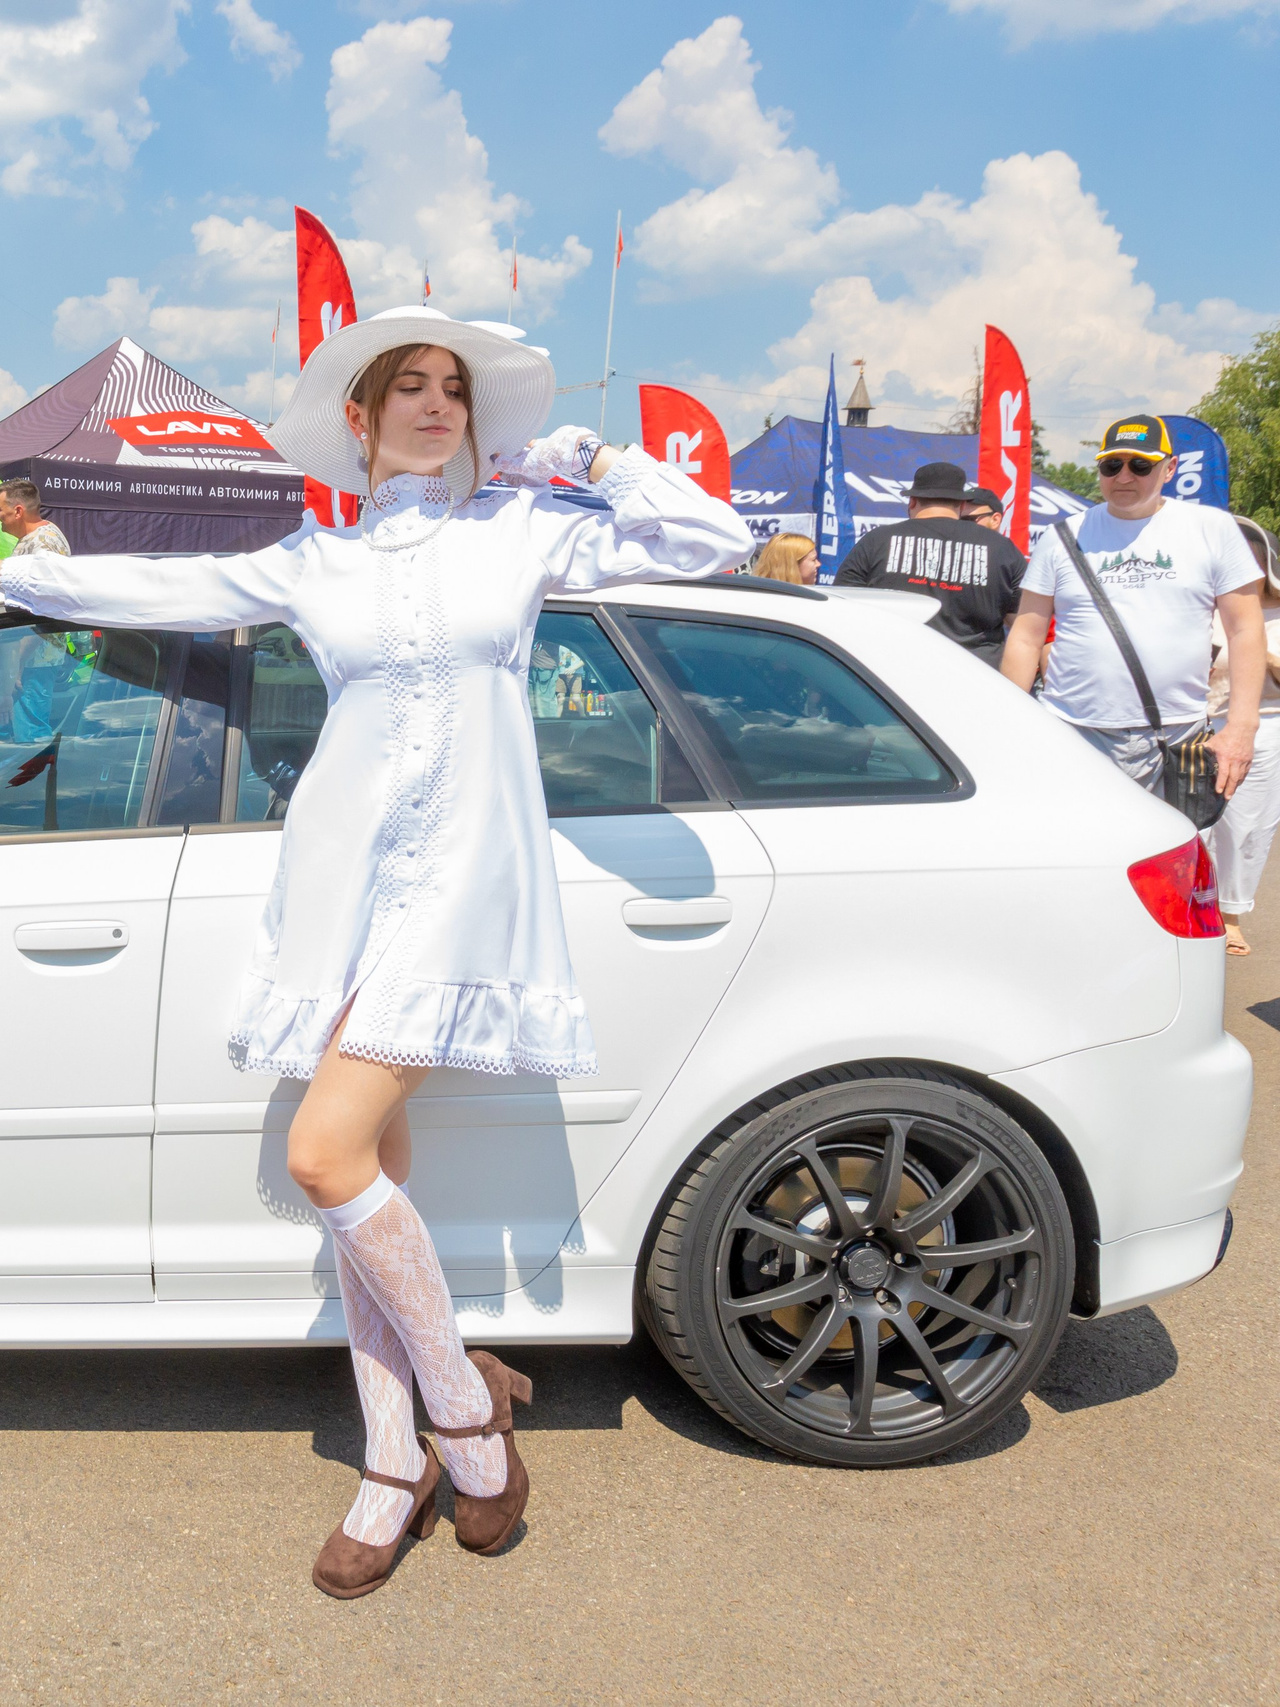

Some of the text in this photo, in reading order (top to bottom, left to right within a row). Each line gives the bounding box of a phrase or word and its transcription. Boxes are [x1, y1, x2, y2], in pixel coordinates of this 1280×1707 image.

[136, 420, 240, 438] LAVR
[158, 446, 262, 459] Твое решение
[44, 476, 122, 494] АВТОХИМИЯ
[129, 482, 204, 497] АВТОКОСМЕТИКА
[208, 486, 280, 502] АВТОХИМИЯ
[979, 1118, 1049, 1193] MICHELIN
